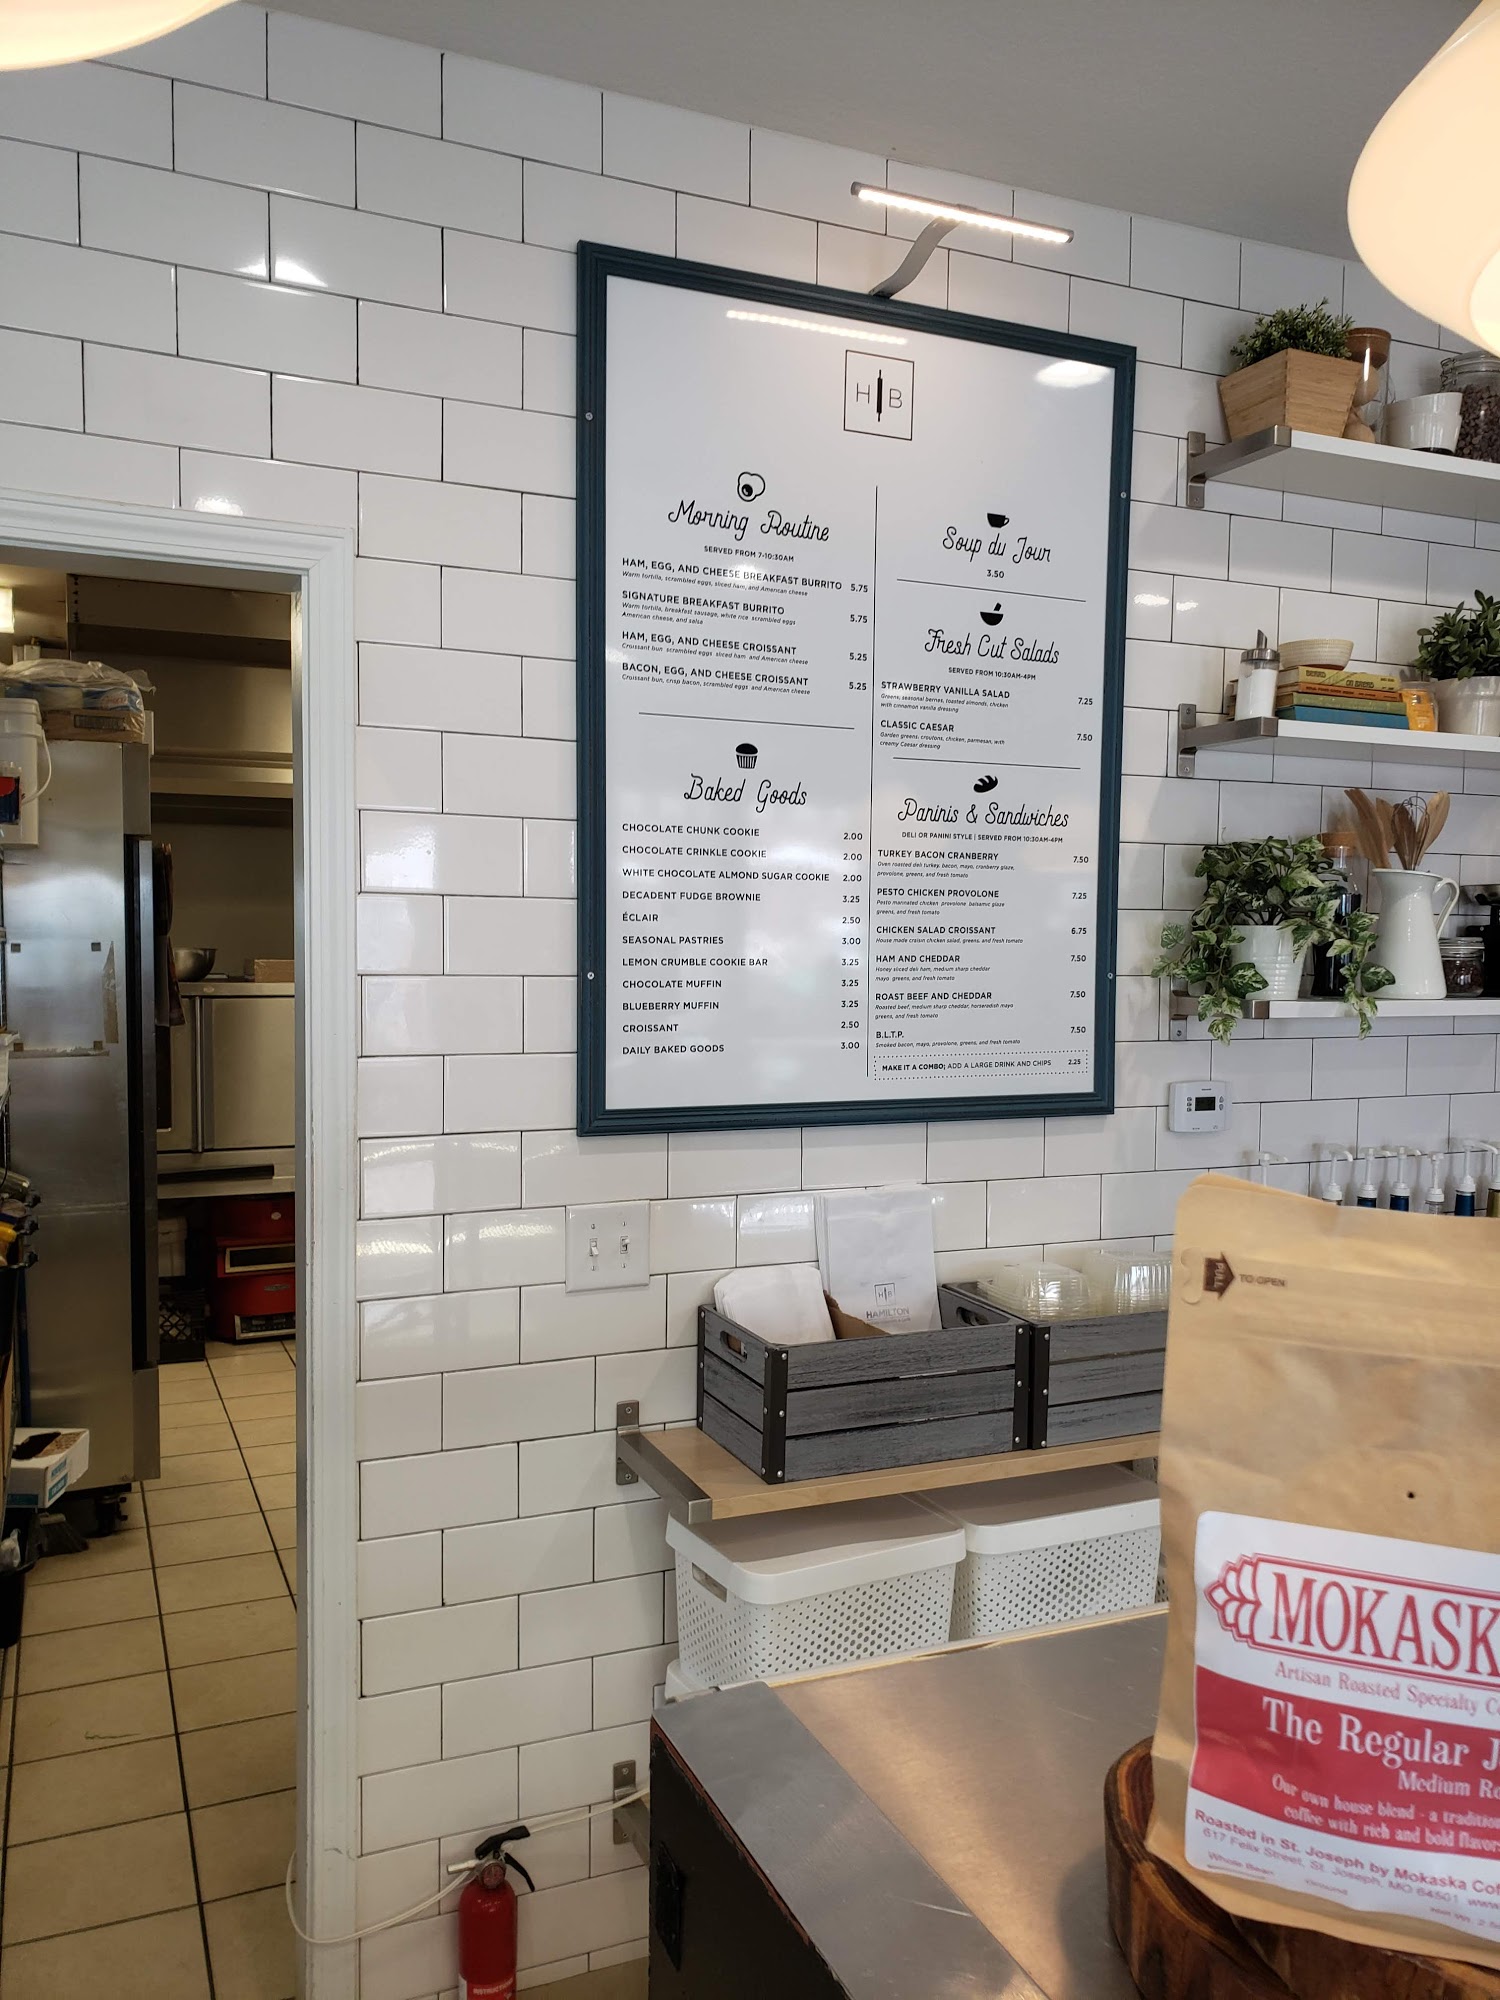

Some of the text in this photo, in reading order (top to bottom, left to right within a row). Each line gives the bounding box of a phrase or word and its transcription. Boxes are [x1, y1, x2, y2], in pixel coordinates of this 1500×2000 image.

[668, 500, 830, 542] Morning Routine
[704, 545, 733, 555] SERVED
[735, 549, 756, 557] FROM
[943, 526, 1051, 564] Soup du Jour
[622, 557, 868, 593] HAM, EGG, AND CHEESE BREAKFAST BURRITO 5.75
[987, 570, 1004, 578] 3.50
[622, 590, 868, 623] SIGNATURE BREAKFAST BURRITO 5.75
[622, 631, 867, 662] HAM, EGG, AND CHEESE CROISSANT 5.25
[925, 628, 1060, 664] Fresh Cut Salads
[622, 662, 866, 691] BACON, EGG, AND CHEESE CROISSANT 5.25
[881, 681, 1093, 705] STRAWBERRY VANILLA SALAD 7.25
[880, 720, 1093, 742] CLASSIC CAESAR 7.50
[684, 773, 807, 813] Baked Goods
[898, 798, 1069, 828] Paninis & Sandwiches
[622, 823, 683, 834] CHOCOLATE
[686, 826, 720, 835] CHUNK
[723, 827, 759, 836] COOKIE
[878, 849, 912, 858] TURKEY
[915, 851, 945, 859] BACON
[948, 851, 998, 860] CRANBERRY
[622, 868, 654, 877] WHITE
[657, 869, 716, 878] CHOCOLATE
[719, 871, 759, 879] ALMOND
[762, 872, 793, 880] SUGAR
[795, 873, 829, 881] COOKIE
[622, 891, 676, 900] DECADENT
[680, 892, 712, 900] FUDGE
[716, 892, 760, 901] BROWNIE
[907, 888, 945, 896] CHICKEN
[948, 889, 999, 898] PROVOLONE
[622, 912, 659, 922] ÉCLAIR
[622, 936, 676, 944] SEASONAL
[679, 936, 724, 944] PASTRIES
[623, 958, 657, 966] LEMON
[661, 958, 706, 966] CRUMBLE
[709, 958, 746, 966] COOKIE
[622, 980, 683, 988] CHOCOLATE
[875, 993, 904, 1001] ROAST
[623, 1021, 859, 1033] CROISSANT 2.50
[876, 1031, 904, 1039] B.L.T.P.
[623, 1041, 860, 1054] DAILY BAKED GOODS 3.00
[1240, 1274, 1285, 1287] TO OPEN
[866, 1307, 910, 1318] HAMILTON
[1276, 1662, 1480, 1716] Artisan Roasted Specialty
[1262, 1696, 1470, 1768] The Regular
[1398, 1770, 1470, 1796] Medium
[1272, 1773, 1438, 1823] Our own house blend a
[1284, 1804, 1454, 1848] coffee with rich and bold
[1194, 1809, 1467, 1891] Roasted in St. Joseph by Mokaska
